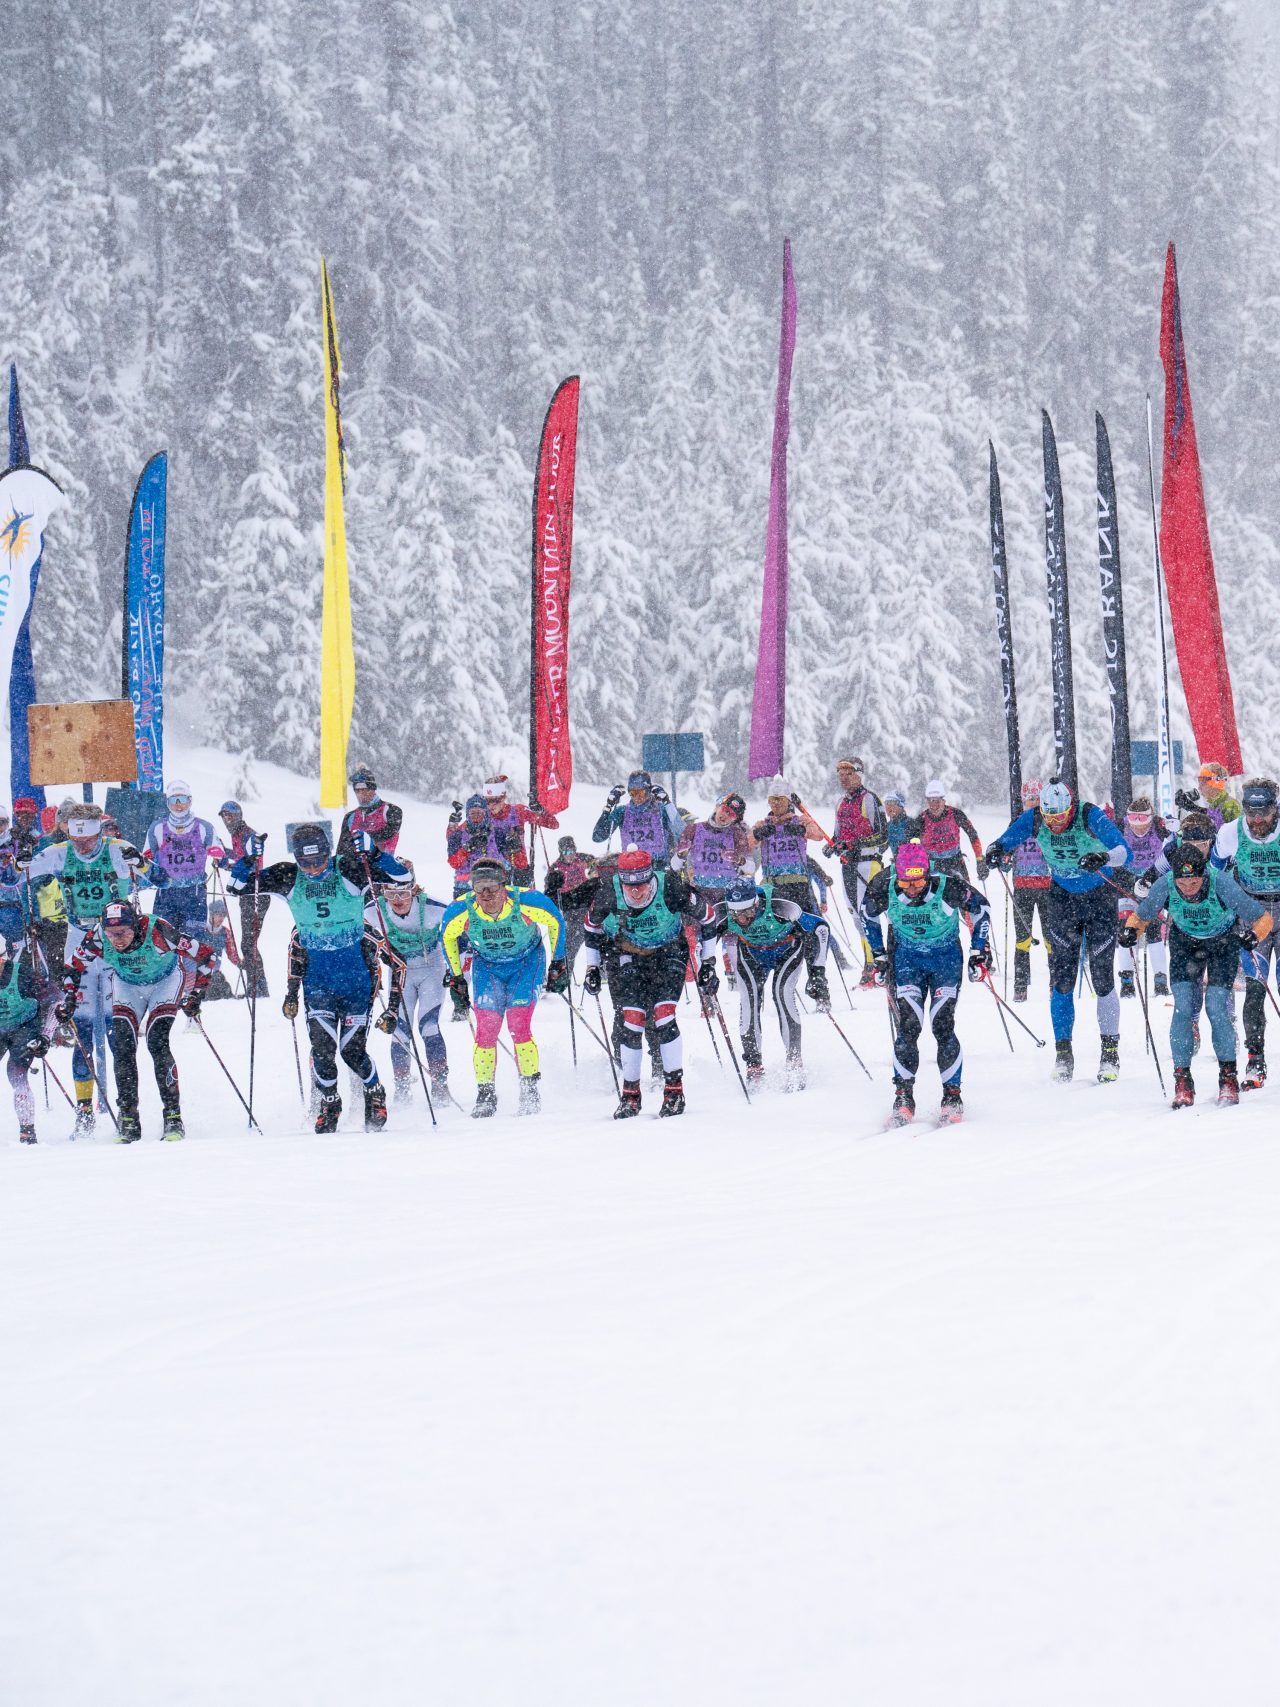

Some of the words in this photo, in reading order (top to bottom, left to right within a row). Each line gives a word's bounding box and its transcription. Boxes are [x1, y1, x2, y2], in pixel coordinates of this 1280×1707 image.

[166, 853, 196, 865] 104
[1053, 849, 1079, 860] 33
[1252, 865, 1280, 878] 35
[76, 886, 104, 900] 49
[306, 883, 336, 891] BOULDER
[316, 902, 331, 918] 5
[482, 927, 512, 936] BOULDER
